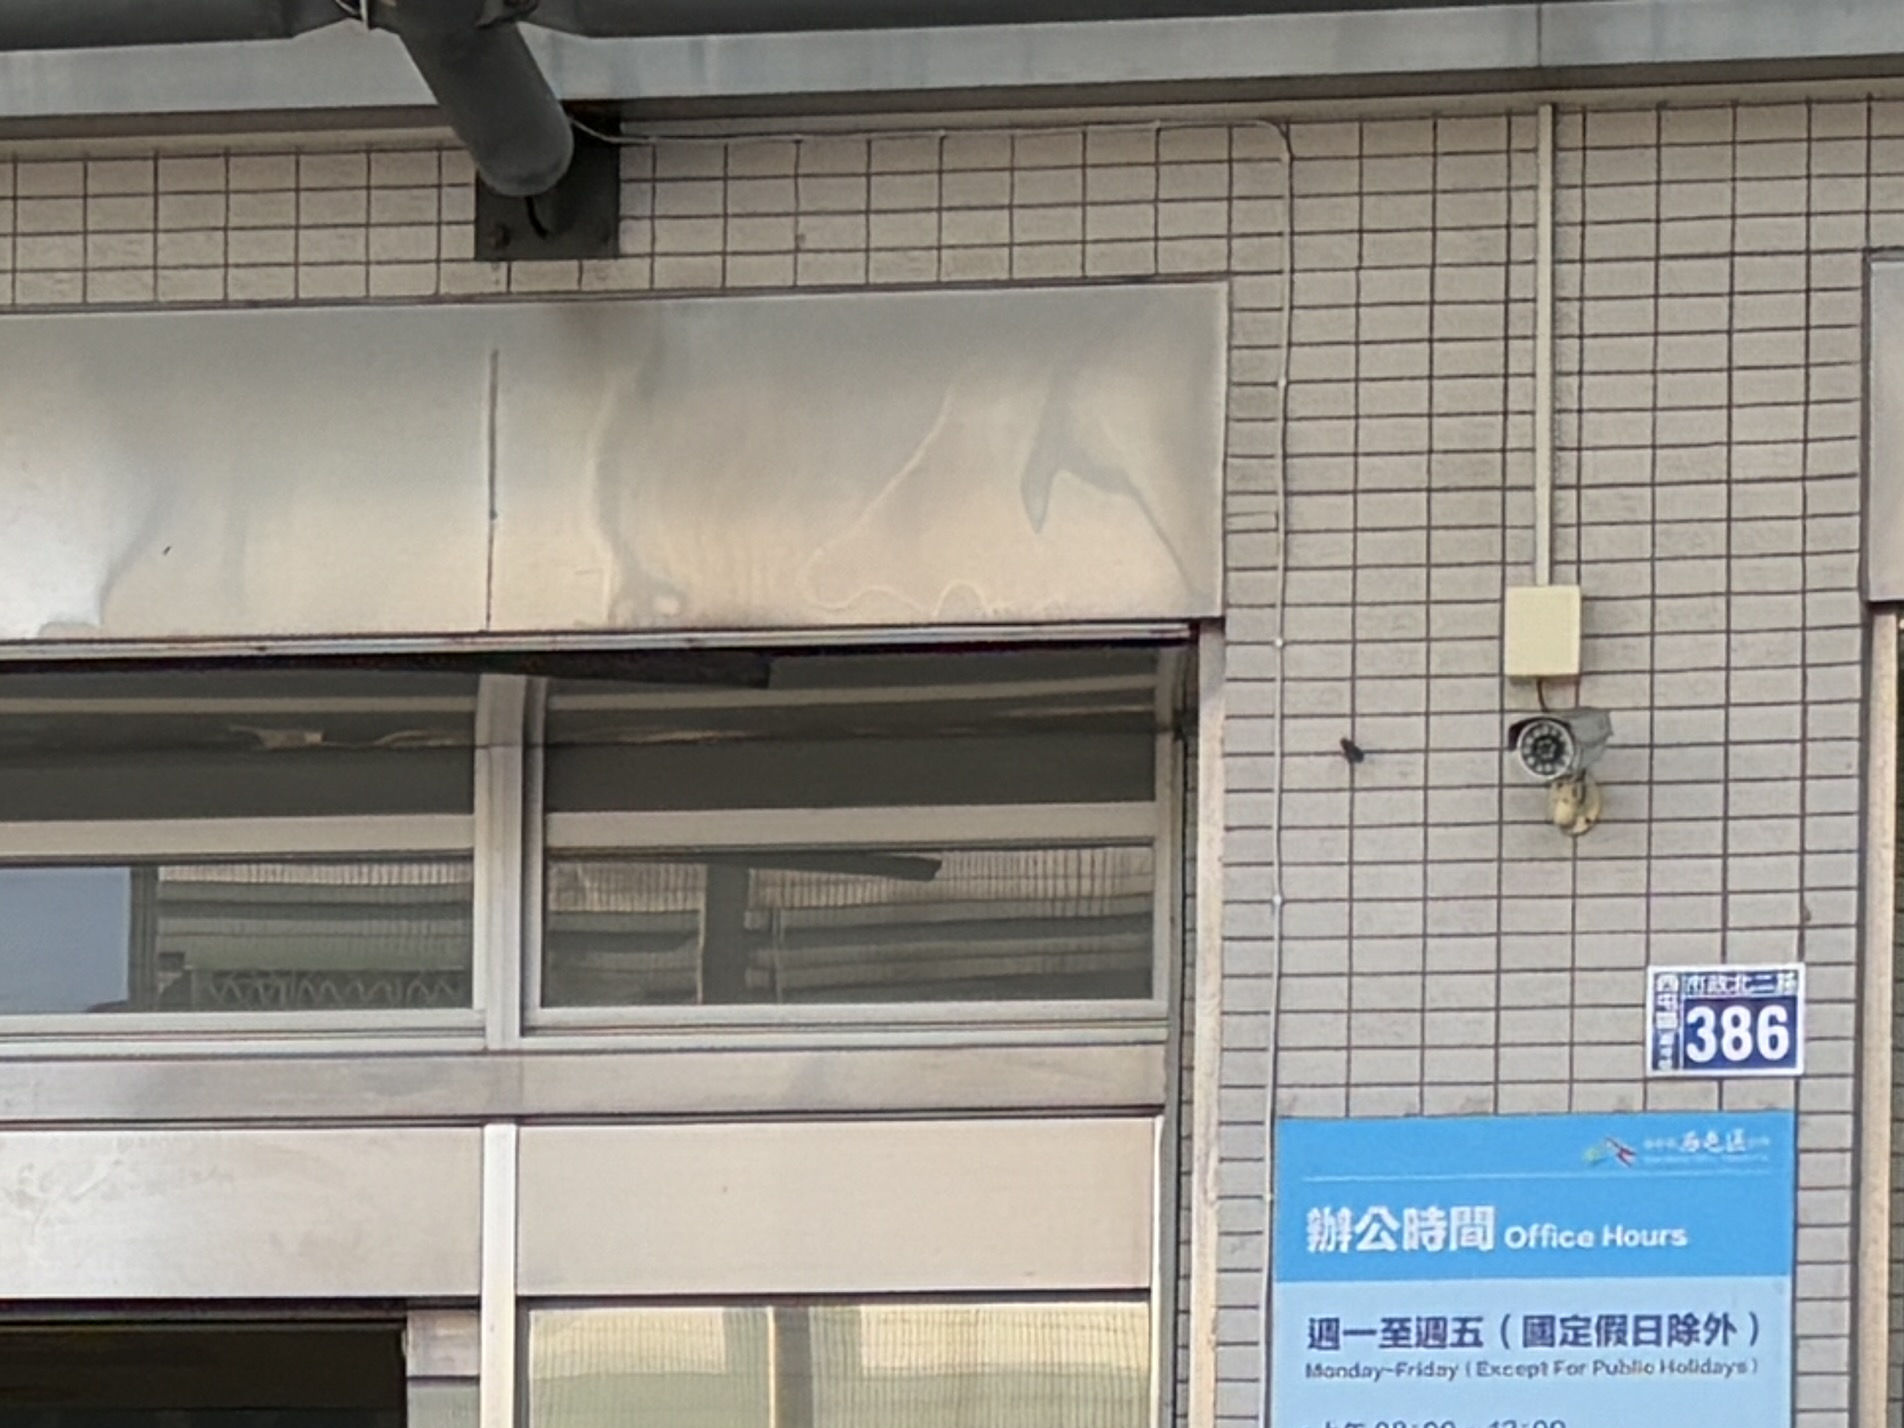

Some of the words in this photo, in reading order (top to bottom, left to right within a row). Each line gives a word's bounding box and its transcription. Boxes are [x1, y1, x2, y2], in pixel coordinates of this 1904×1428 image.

[1686, 1005, 1790, 1063] 386
[1306, 1205, 1496, 1254] 辦公時間
[1504, 1223, 1594, 1250] Office
[1602, 1223, 1689, 1248] Hours
[1553, 1359, 1587, 1377] For
[1592, 1358, 1656, 1376] Public
